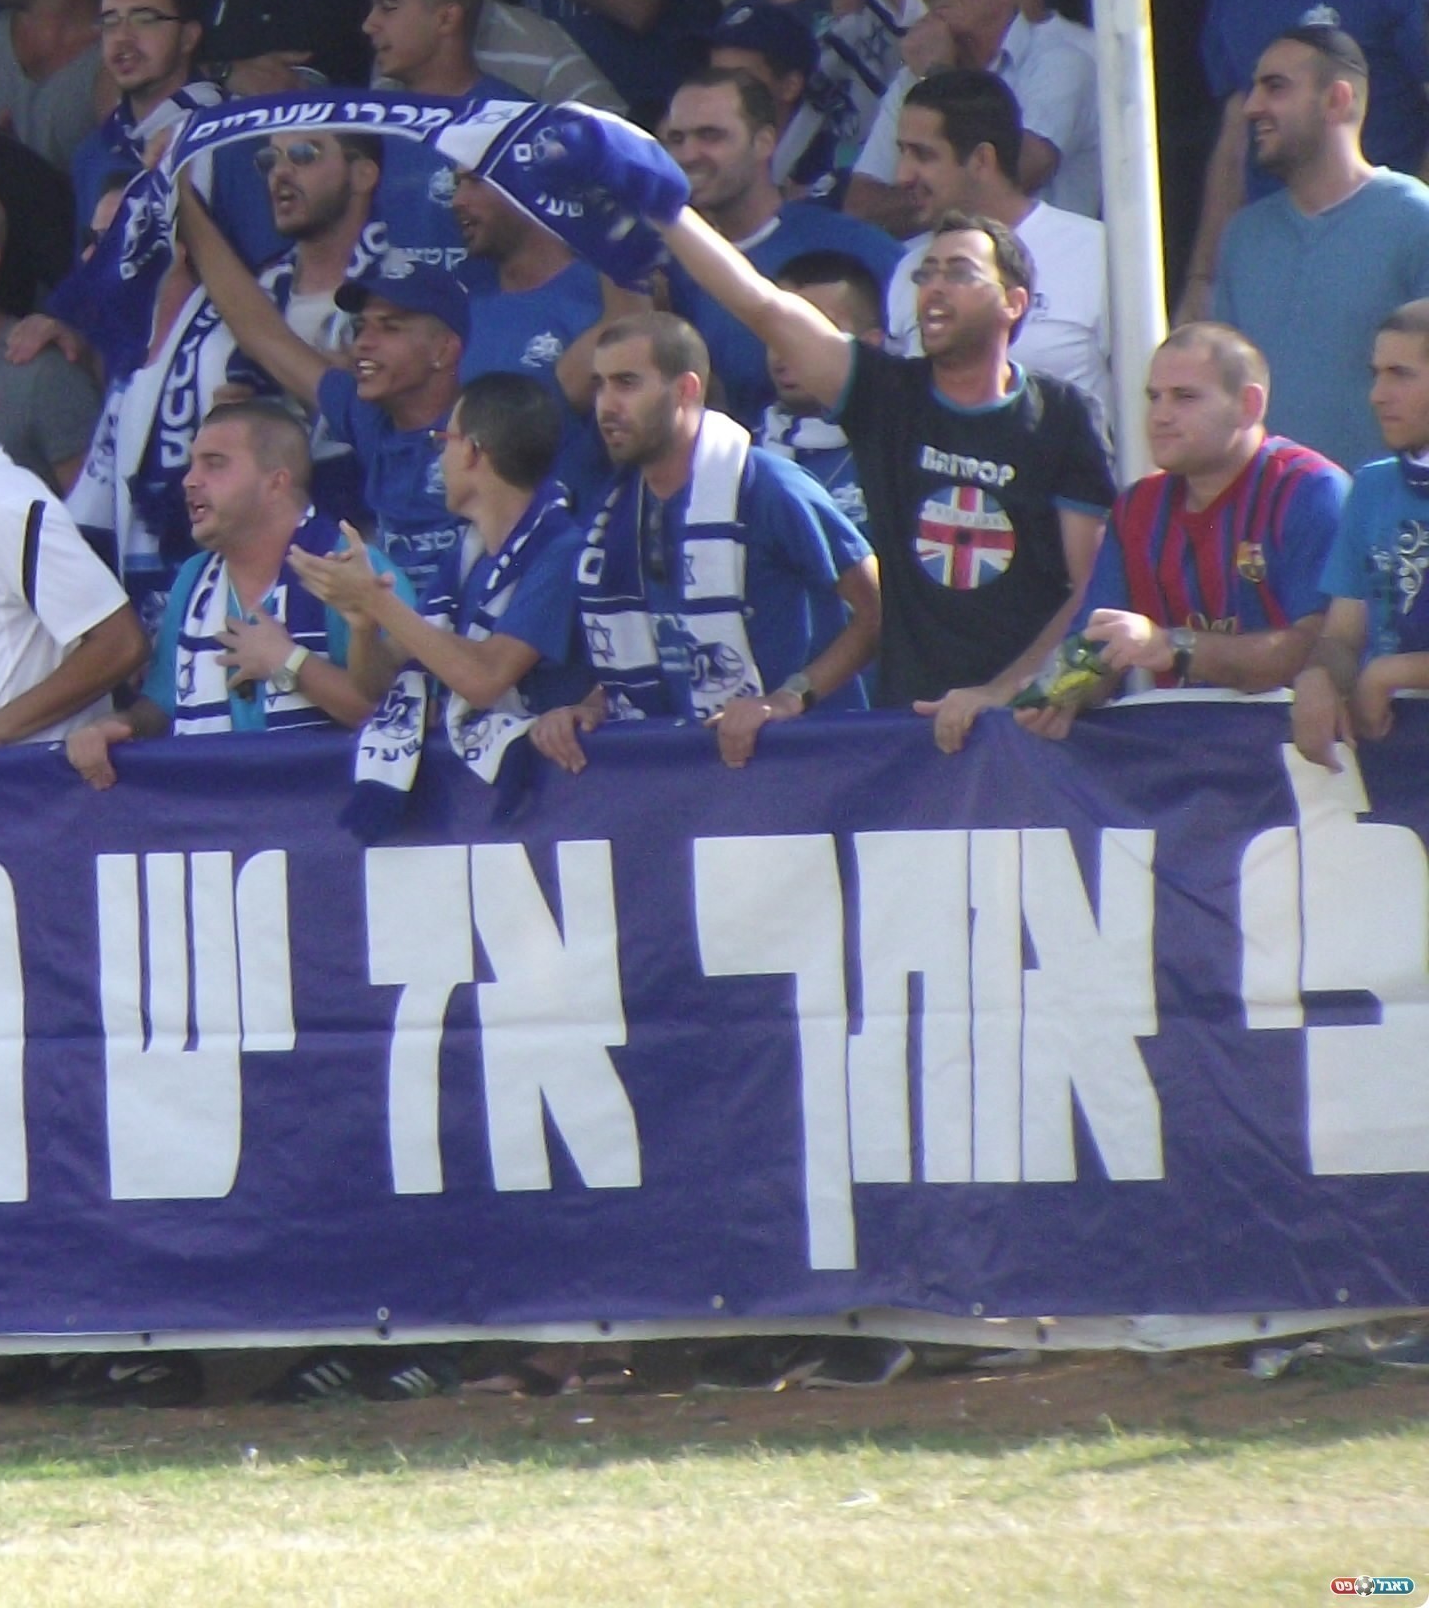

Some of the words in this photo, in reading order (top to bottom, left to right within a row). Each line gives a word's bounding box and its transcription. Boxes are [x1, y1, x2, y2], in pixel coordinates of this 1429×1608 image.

[187, 103, 337, 143] שעריים
[95, 849, 297, 1200] יש
[365, 839, 642, 1194] אז
[693, 826, 1165, 1271] אותך
